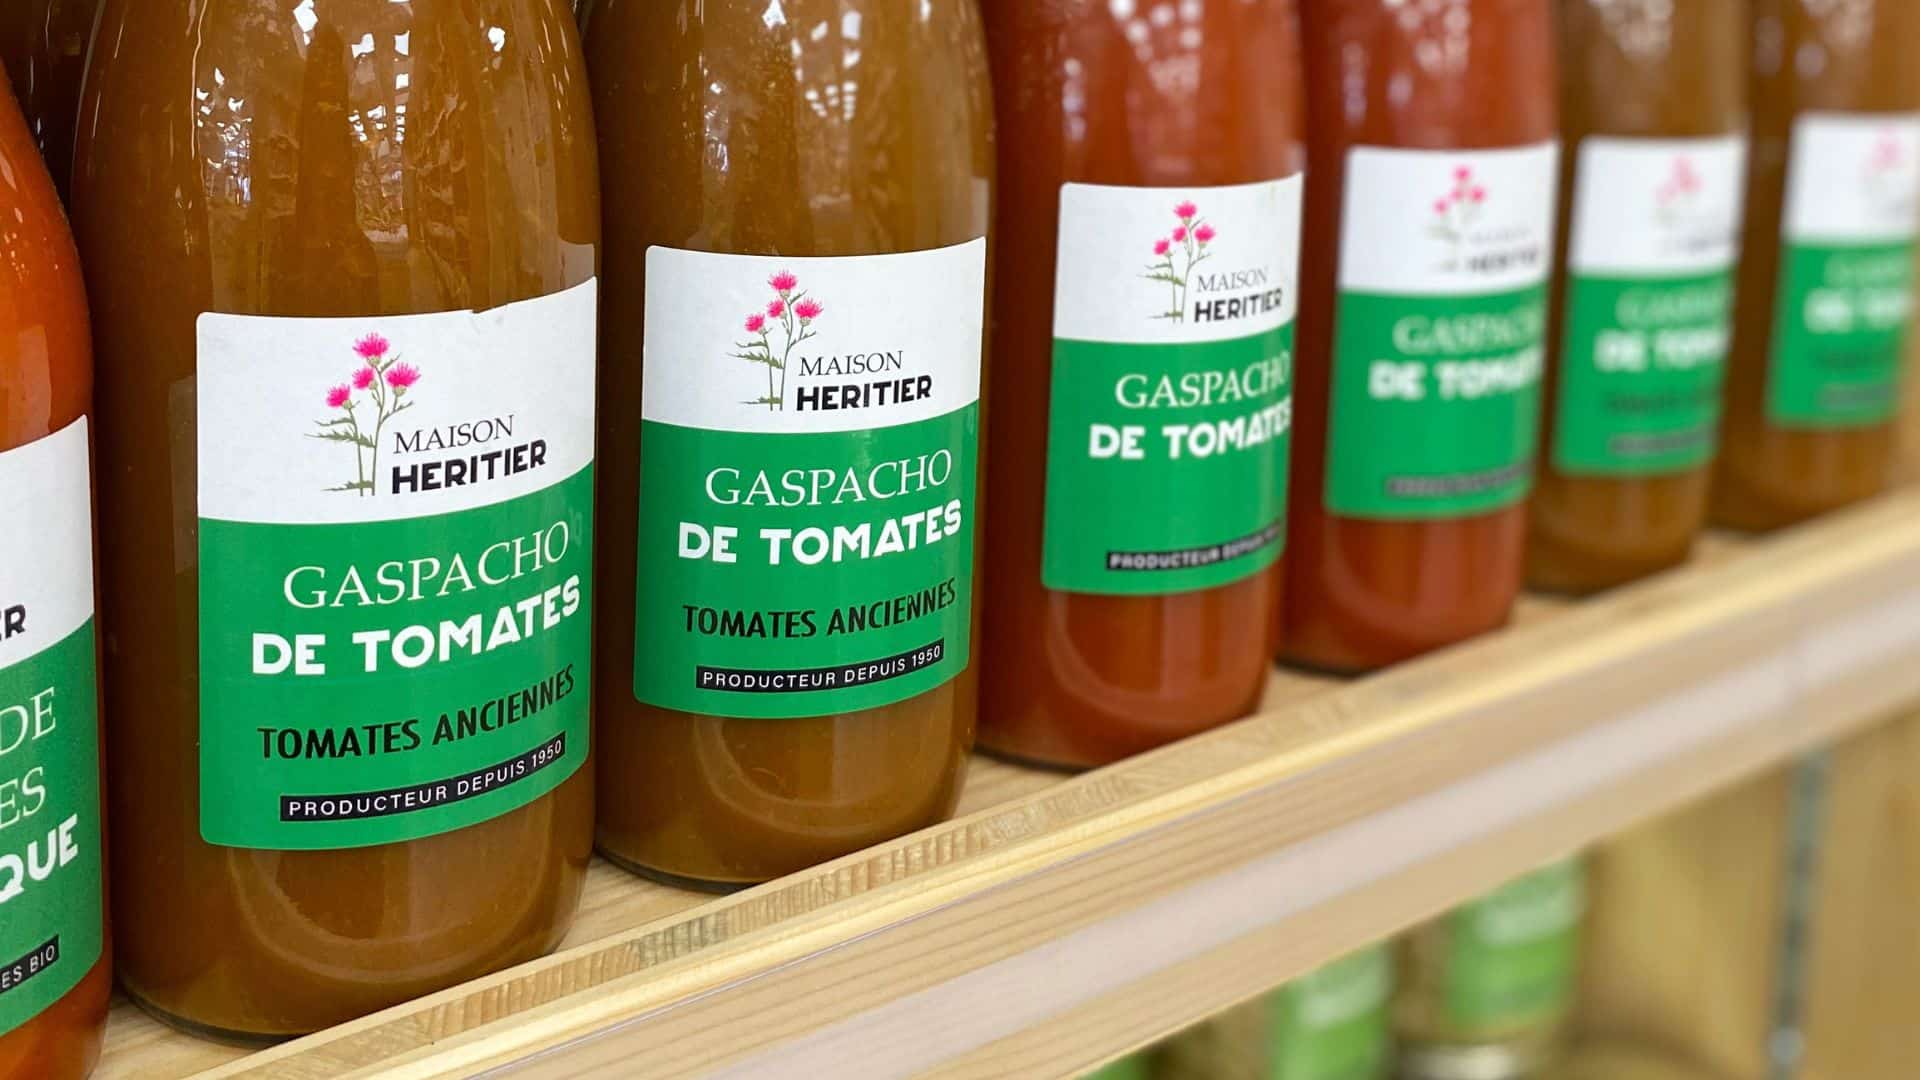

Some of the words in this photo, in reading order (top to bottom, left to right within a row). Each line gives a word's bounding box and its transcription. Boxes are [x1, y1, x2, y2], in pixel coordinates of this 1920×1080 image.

[1194, 288, 1282, 323] HERITIER
[799, 350, 903, 377] MAISON
[797, 375, 933, 411] HERITIER
[394, 414, 515, 454] MAISON
[1089, 423, 1146, 459] DE
[391, 438, 547, 494] HERITIER
[705, 449, 952, 506] GASPACHO
[678, 521, 738, 563] DE
[760, 499, 961, 565] TOMATES
[283, 520, 570, 608] GASPACHO
[252, 632, 326, 675] DE
[352, 574, 580, 673] TOMATES
[682, 604, 817, 639] TOMATES
[827, 577, 956, 636] ANCIENNES
[703, 671, 836, 688] PRODUCTEUR
[845, 658, 906, 683] DEPUIS
[911, 645, 941, 668] 1950
[257, 719, 420, 760] TOMATES
[432, 664, 575, 746] ANCIENNES
[289, 785, 447, 816] PRODUCTEUR
[457, 761, 525, 796] DEPUIS
[531, 739, 563, 769] 1950
[30, 944, 55, 973] BIO
